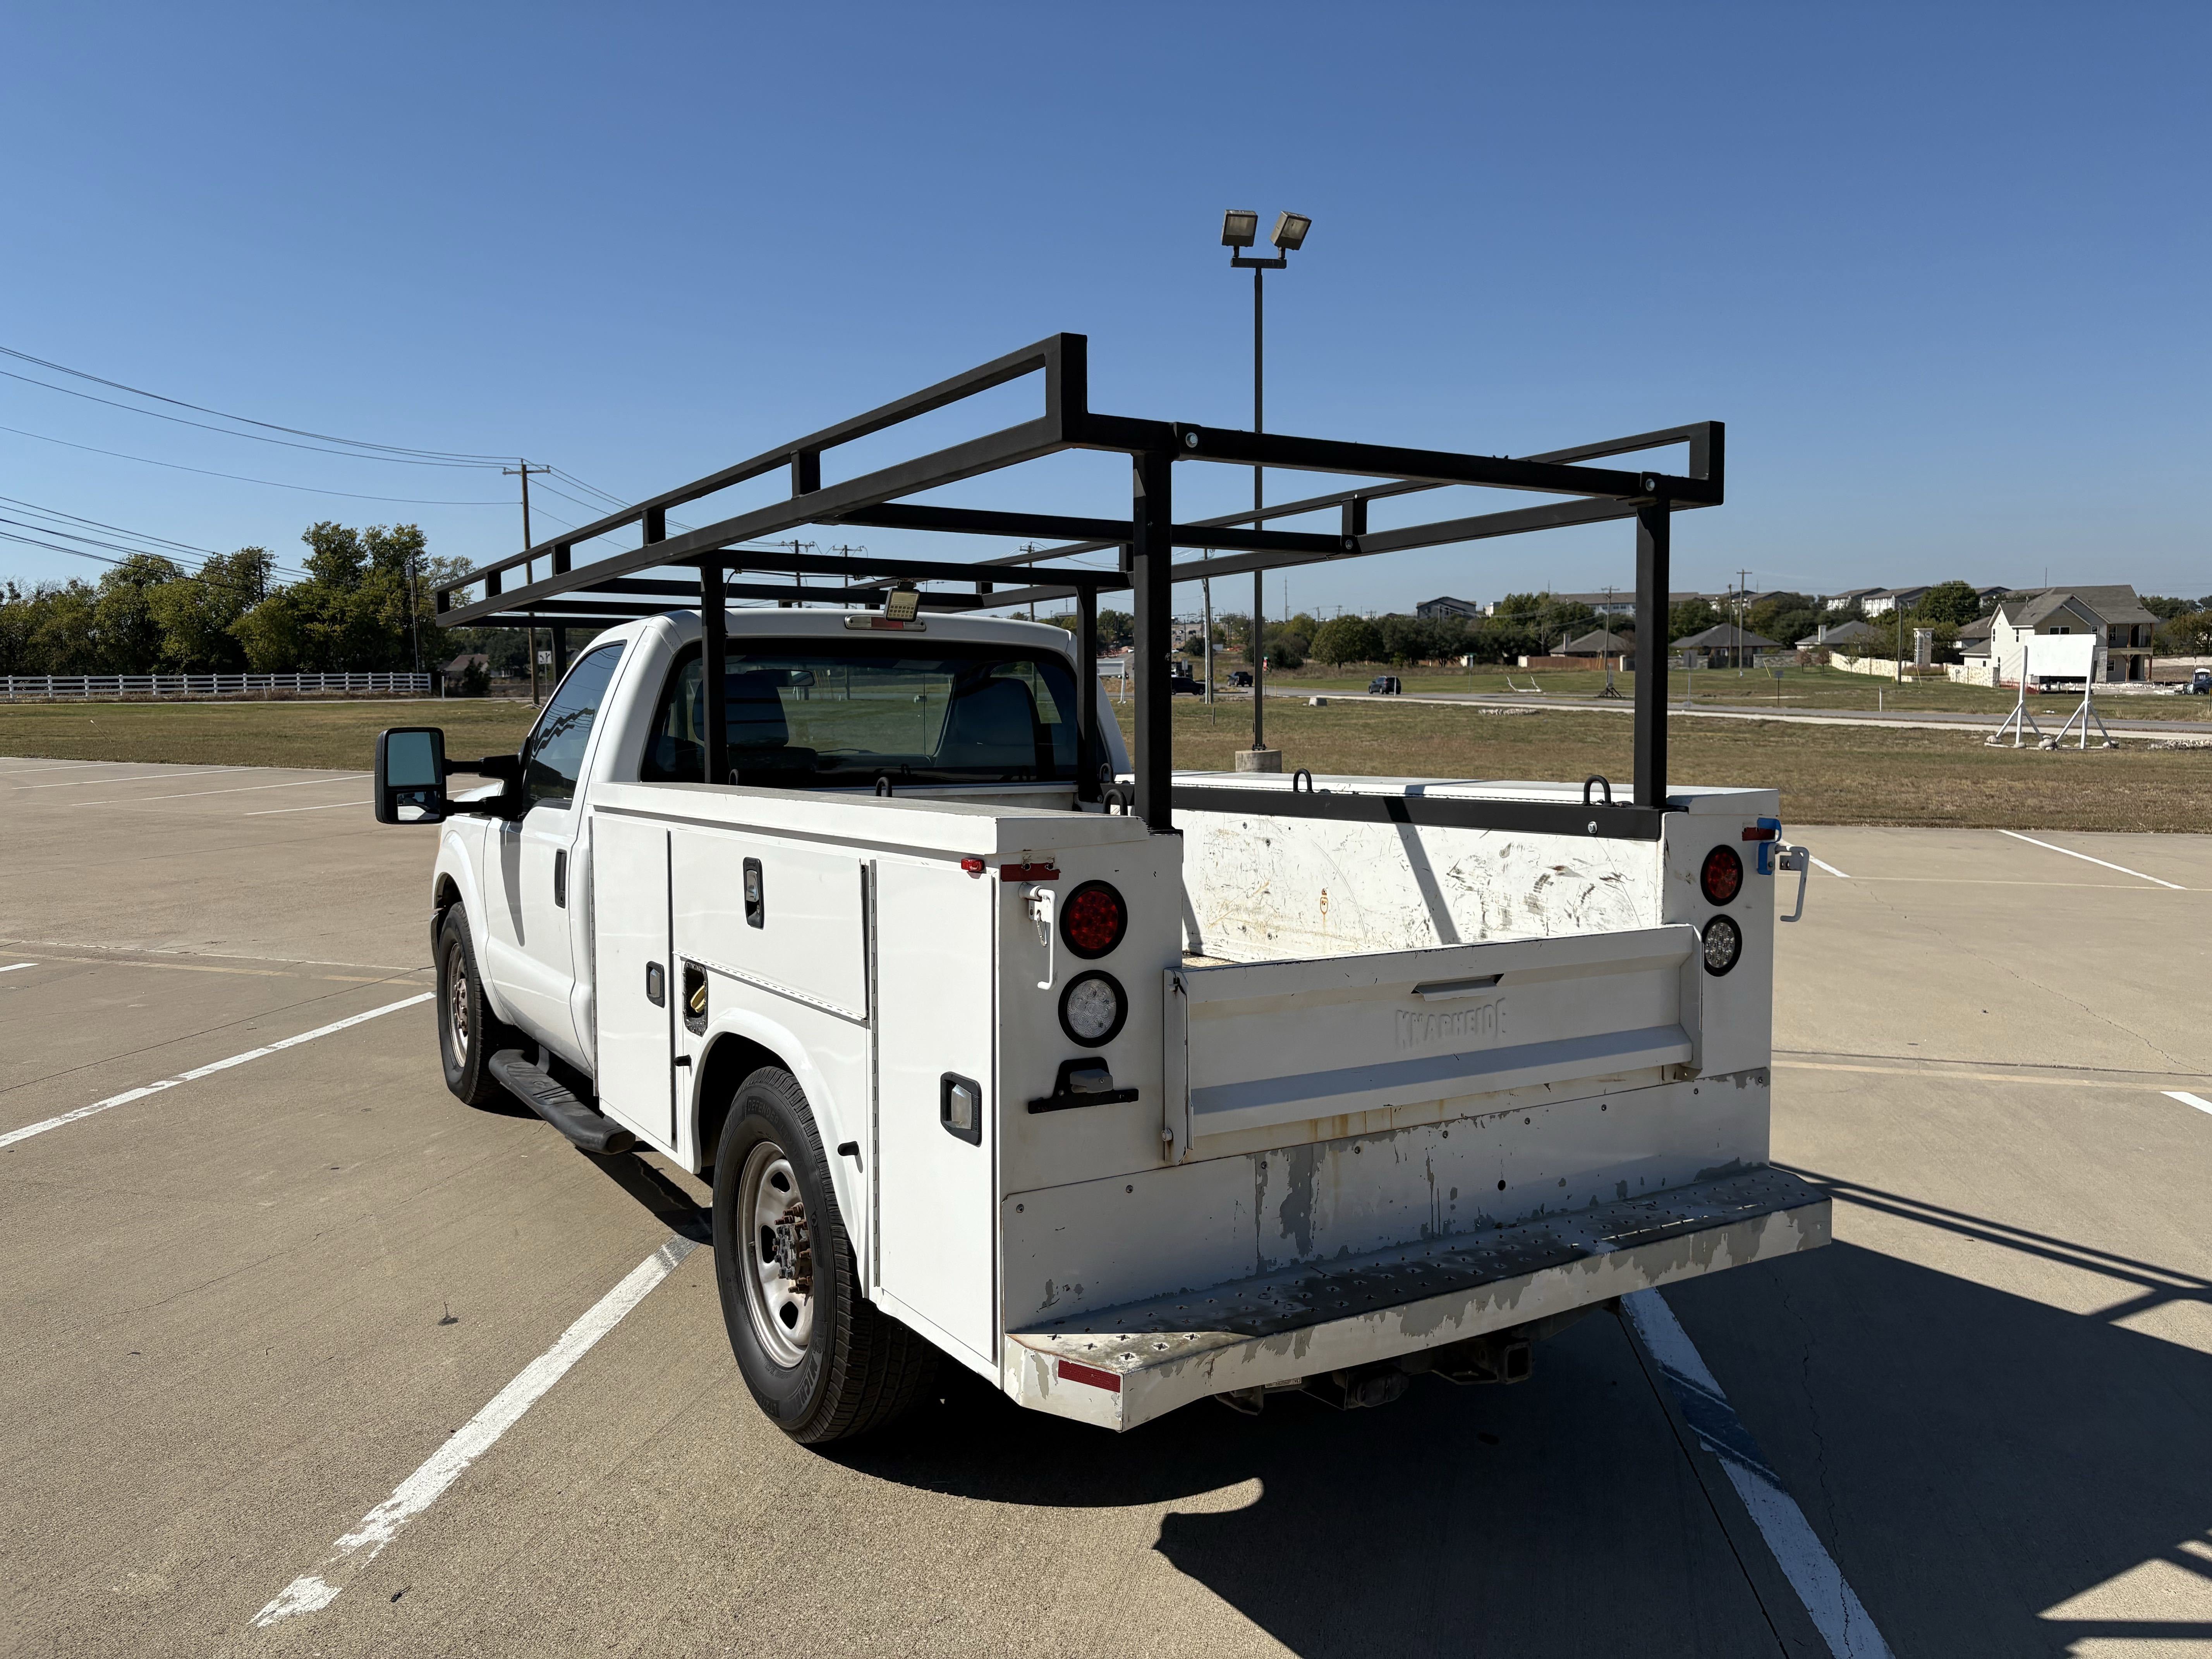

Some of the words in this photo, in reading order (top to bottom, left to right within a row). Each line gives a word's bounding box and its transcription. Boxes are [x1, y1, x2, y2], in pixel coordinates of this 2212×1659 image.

[1396, 997, 1506, 1049] KNAPHEIDE
[747, 1099, 779, 1124] DEFENDER
[789, 1353, 818, 1413] MICHE
